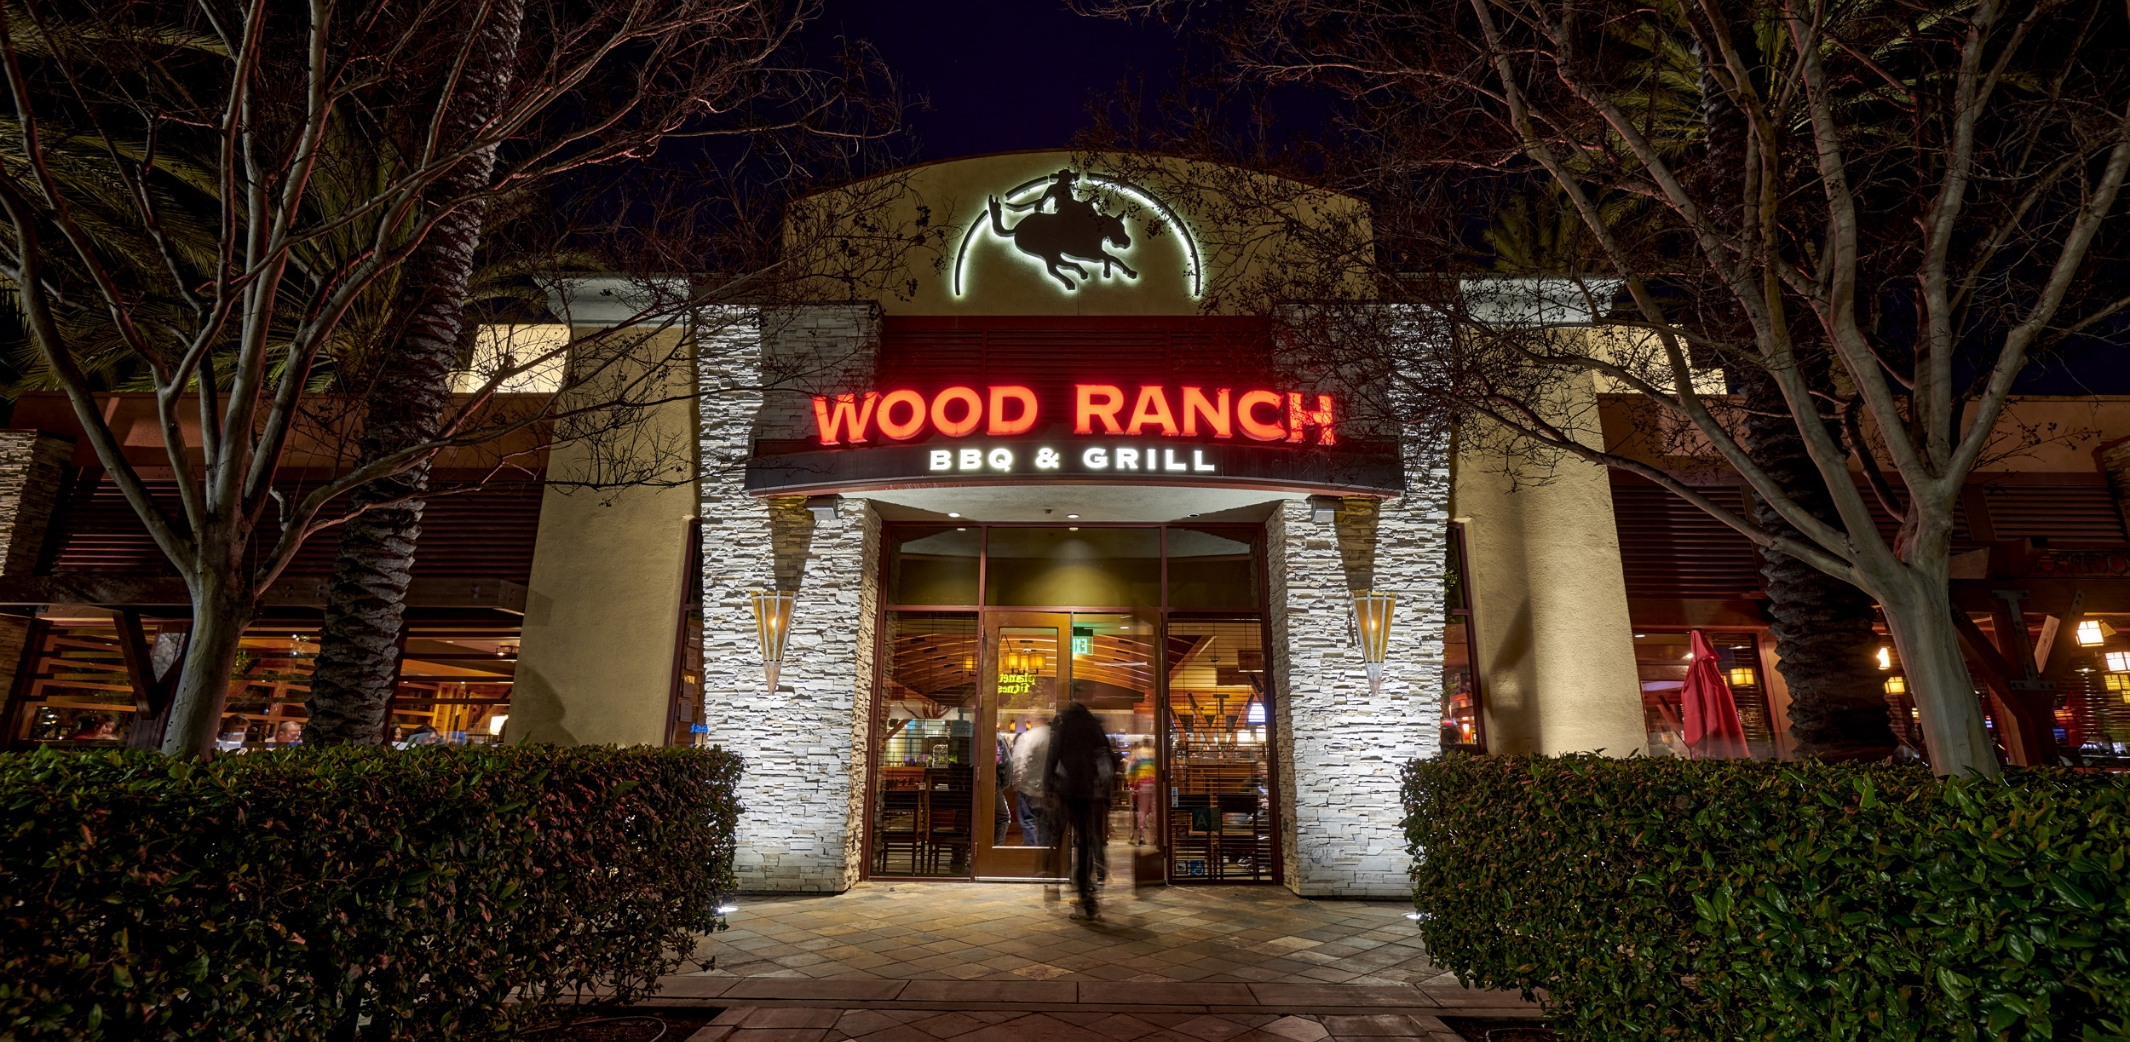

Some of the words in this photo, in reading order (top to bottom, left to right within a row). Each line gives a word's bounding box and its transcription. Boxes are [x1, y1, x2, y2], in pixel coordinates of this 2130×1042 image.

[812, 385, 1039, 445] WOOD
[1074, 384, 1336, 445] RANCH
[929, 447, 1013, 472] BBQ
[1035, 447, 1060, 469] &
[1083, 447, 1215, 471] GRILL
